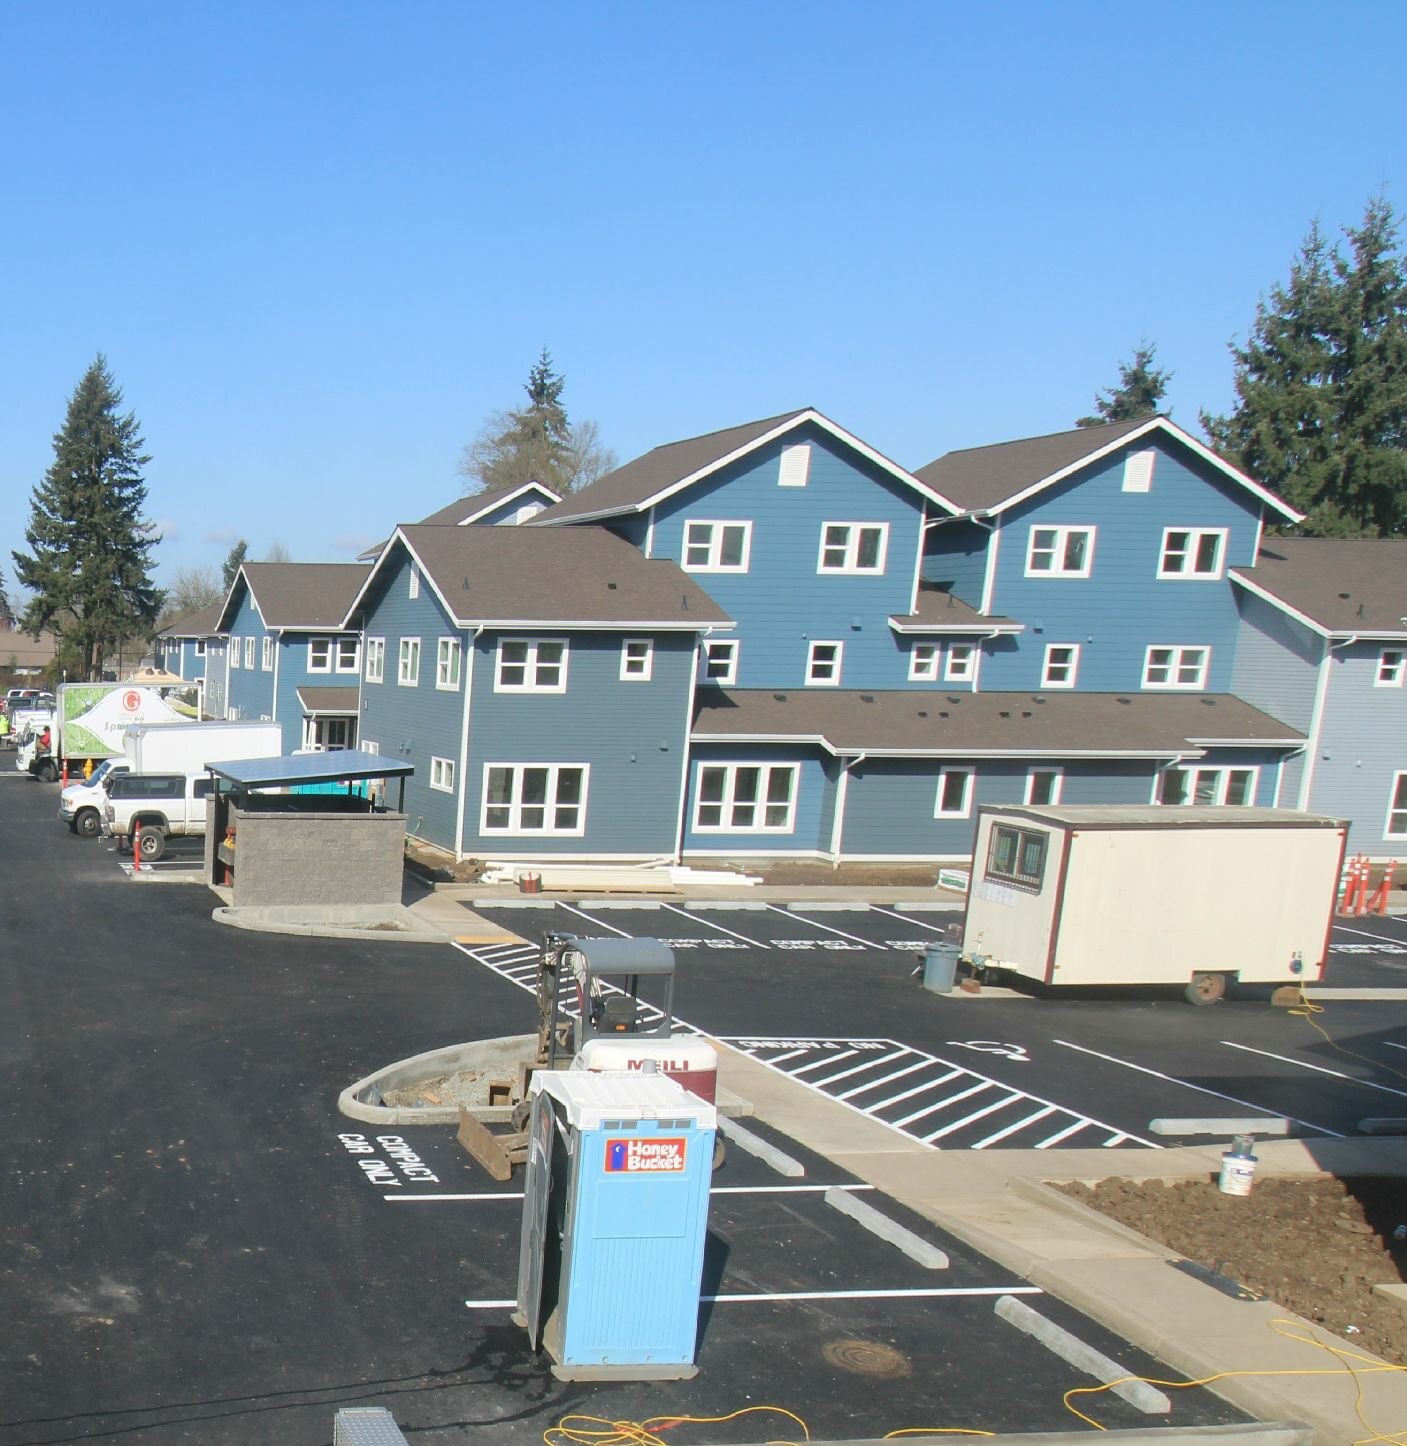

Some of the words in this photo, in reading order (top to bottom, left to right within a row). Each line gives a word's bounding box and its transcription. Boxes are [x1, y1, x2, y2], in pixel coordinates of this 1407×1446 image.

[337, 1133, 375, 1154] CAR
[357, 1160, 403, 1186] ONLY
[376, 1135, 440, 1183] COMPACT
[627, 1140, 680, 1157] Honey
[627, 1154, 683, 1171] Bucket
